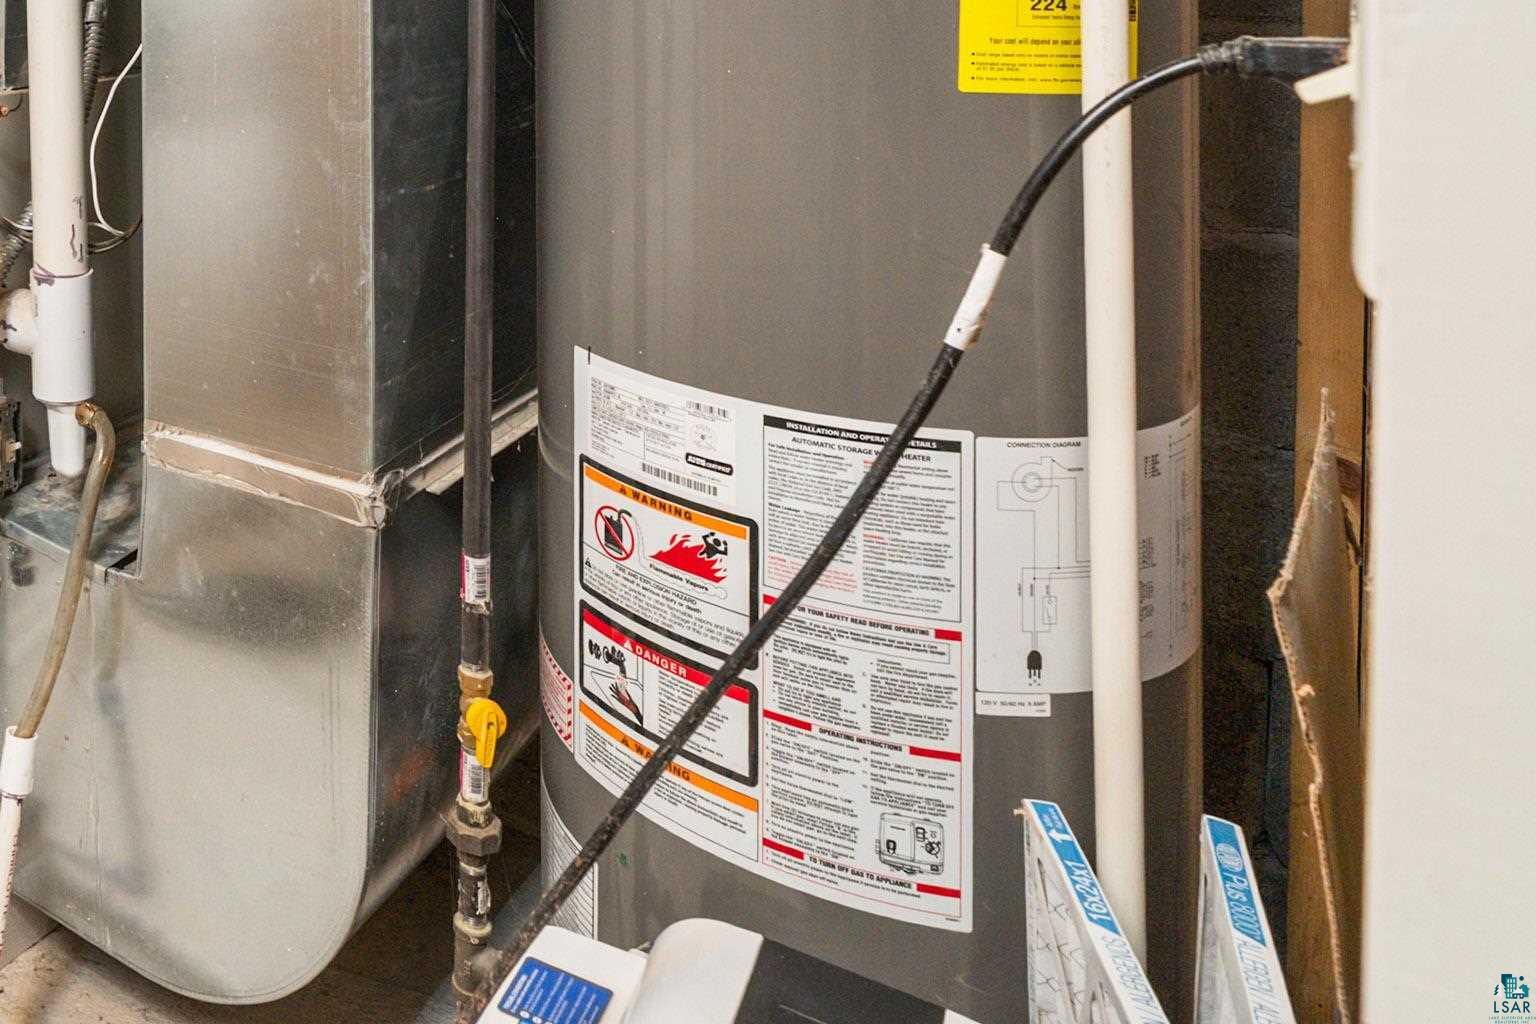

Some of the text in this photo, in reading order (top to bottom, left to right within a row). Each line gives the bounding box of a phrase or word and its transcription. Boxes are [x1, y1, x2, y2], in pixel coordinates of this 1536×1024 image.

[786, 422, 840, 437] INSTALLATION
[841, 431, 859, 440] AND
[791, 436, 837, 451] AUTOMATIC
[837, 444, 874, 456] STORAGE
[631, 488, 693, 521] WARNING
[807, 608, 825, 617] YOUR
[825, 612, 850, 622] SAFETY
[850, 617, 868, 627] READ
[868, 621, 893, 631] BEFORE
[894, 625, 930, 636] OPERATING
[635, 644, 687, 678] DANGER
[819, 726, 903, 752] OPERATING INSTRUCTIONS
[634, 742, 691, 781] WAING
[818, 858, 837, 870] TURN
[837, 864, 850, 873] OFF
[850, 868, 865, 878] GAS
[876, 875, 913, 890] APPLIANCE
[1222, 872, 1250, 903] Plus
[1064, 860, 1113, 922] 16x24x1
[1230, 900, 1262, 940] 8000
